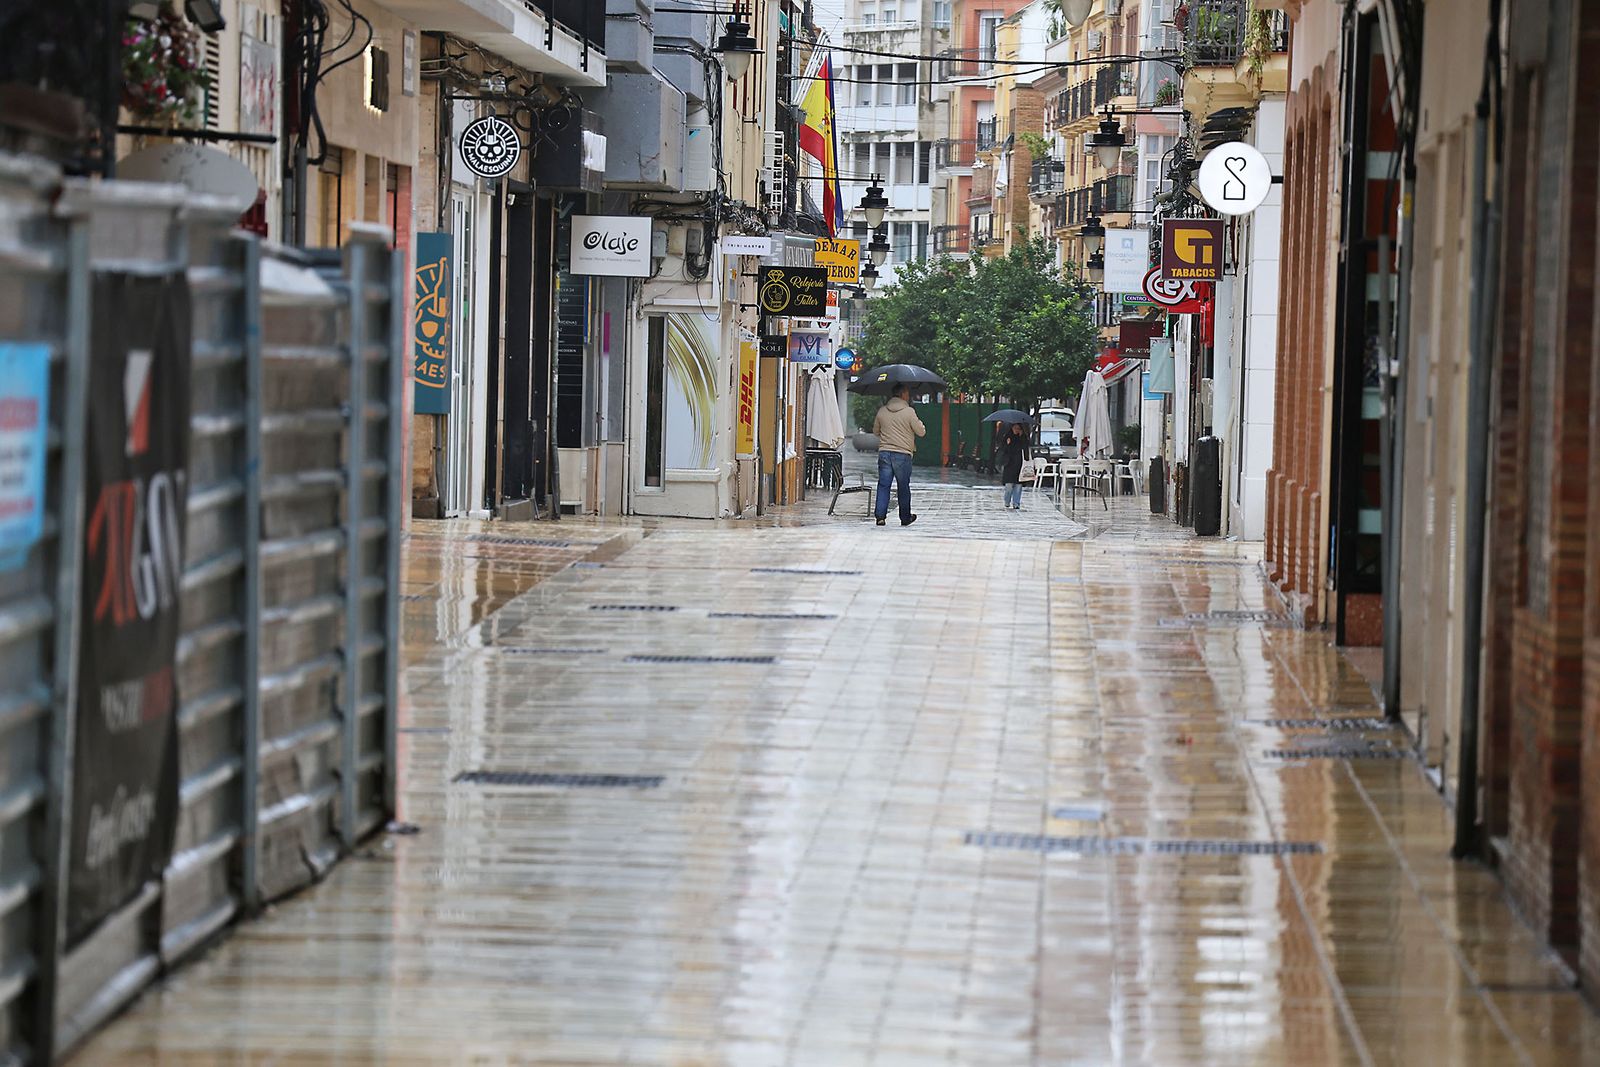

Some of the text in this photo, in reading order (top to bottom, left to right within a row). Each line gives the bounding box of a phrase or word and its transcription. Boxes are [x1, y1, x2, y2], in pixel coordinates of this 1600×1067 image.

[467, 153, 514, 173] MALAESQUINA
[583, 231, 638, 255] Olaje
[815, 241, 857, 261] DEMAR
[1171, 268, 1216, 277] TABACOS
[794, 294, 818, 306] Taller
[740, 369, 754, 425] DHL
